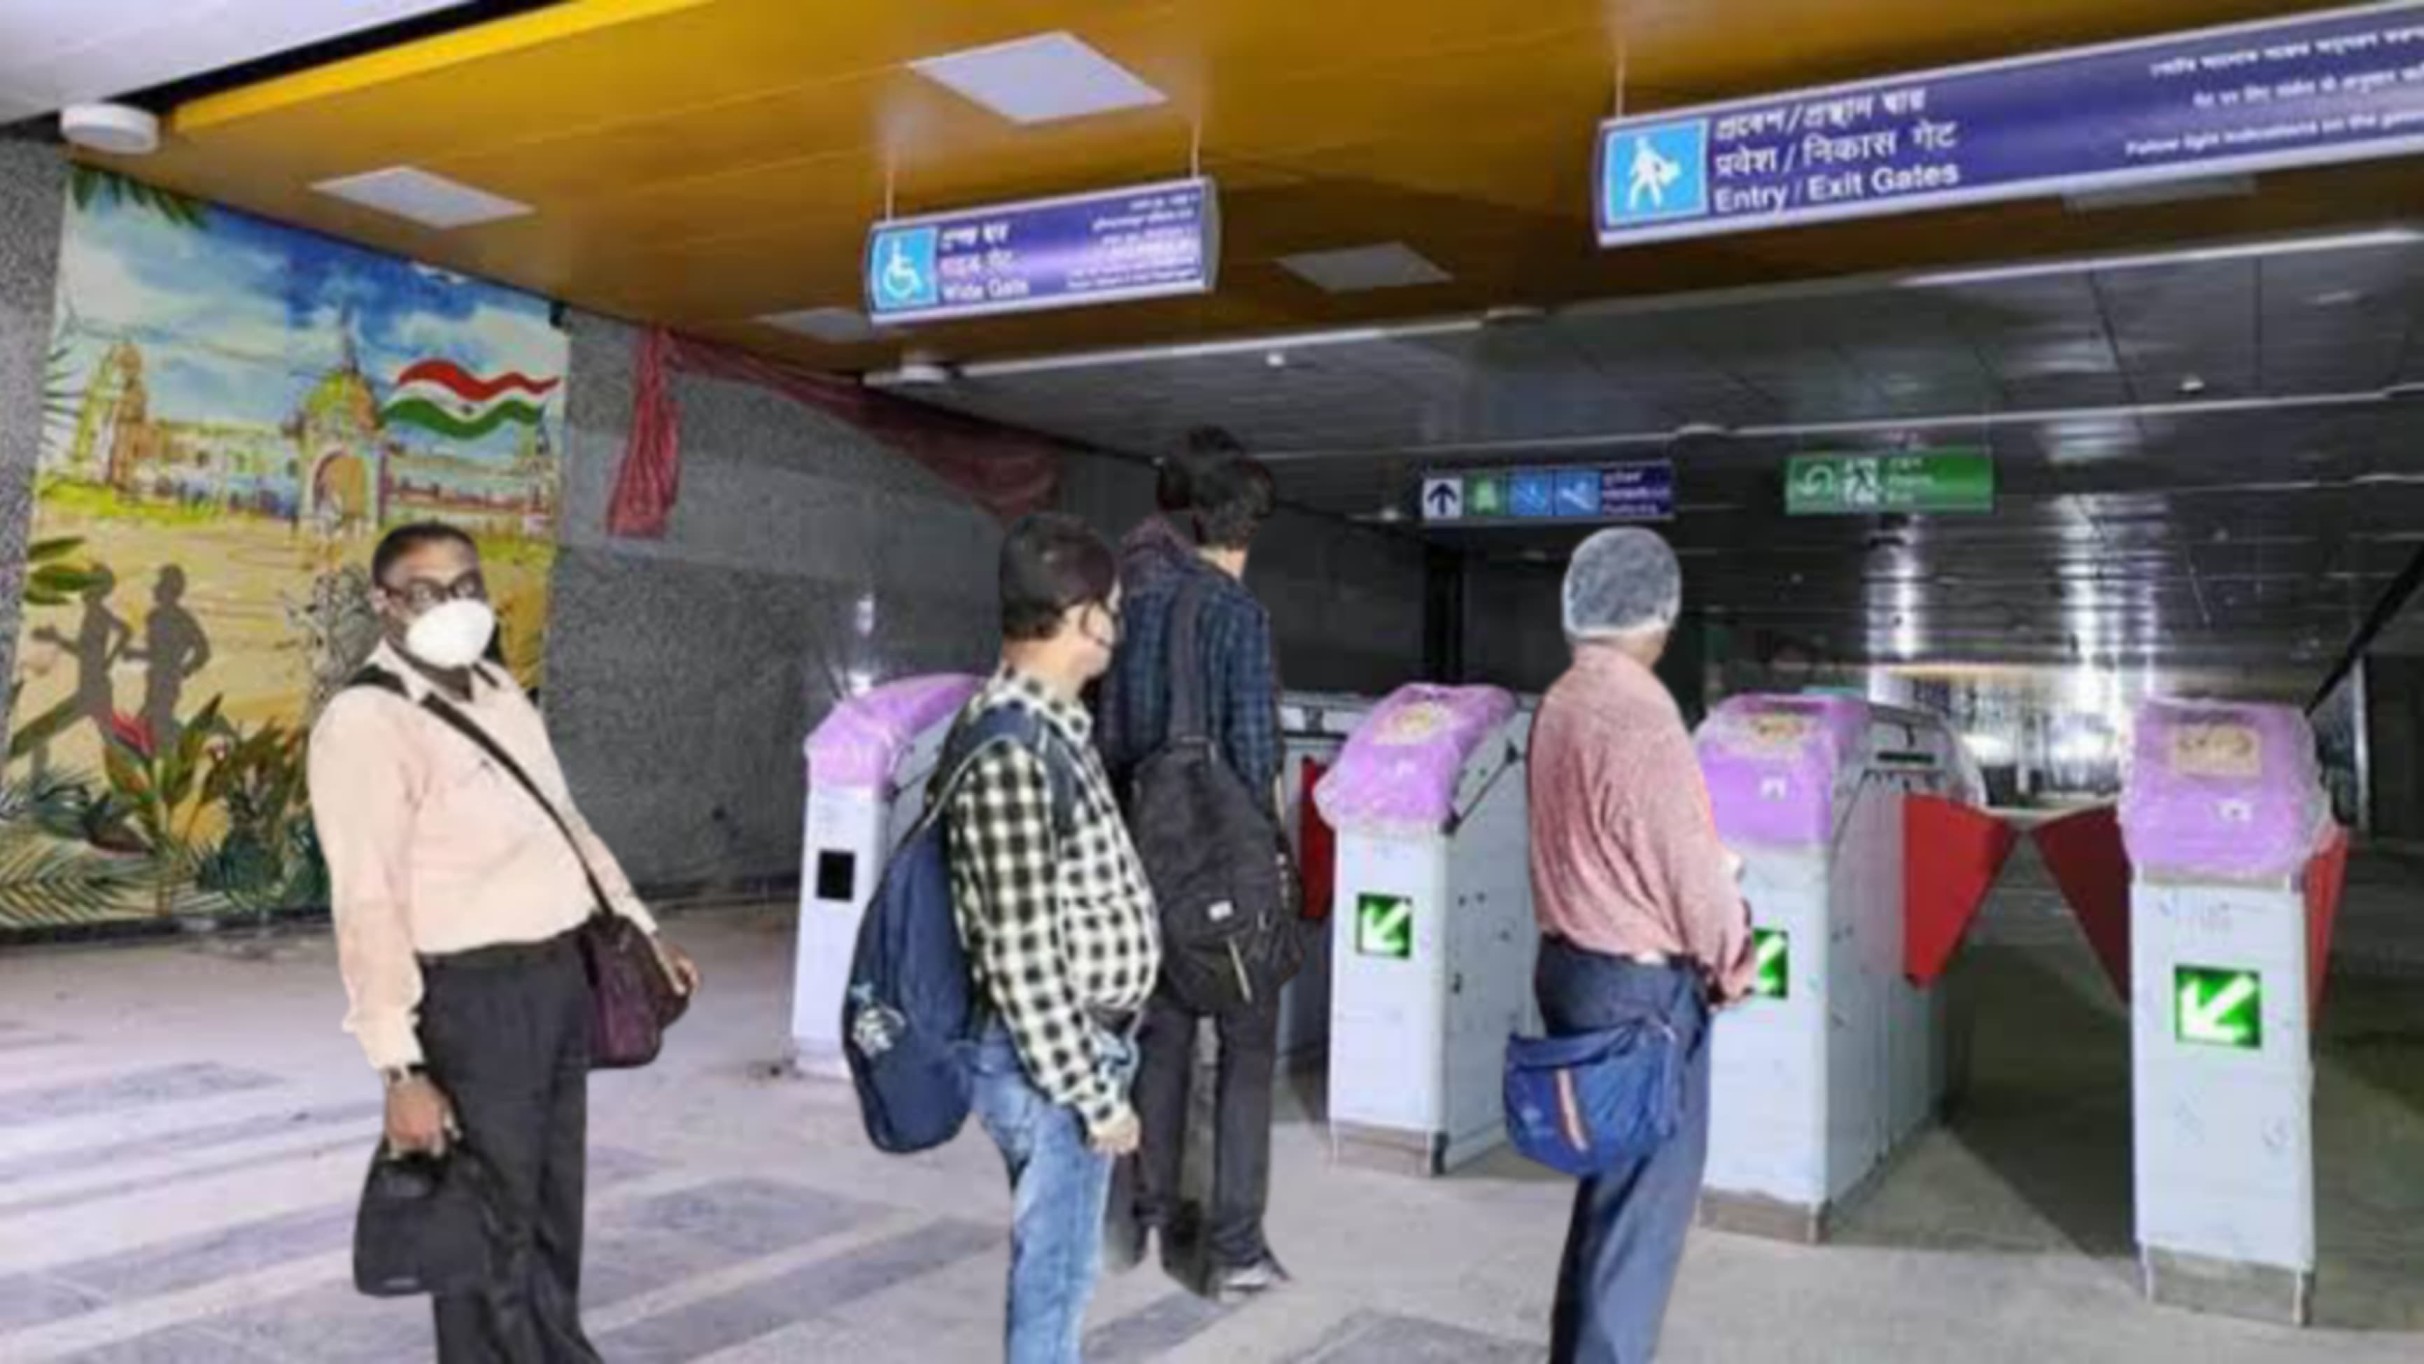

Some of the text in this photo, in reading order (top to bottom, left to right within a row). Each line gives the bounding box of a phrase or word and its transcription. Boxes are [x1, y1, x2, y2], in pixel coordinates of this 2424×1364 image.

[1716, 143, 1778, 178] प्रवेश
[1803, 129, 1897, 168] निकास
[1911, 117, 1959, 150] गेट
[1714, 183, 1789, 215] Entry
[1807, 170, 1863, 201] Exit
[1871, 163, 1961, 195] Gates
